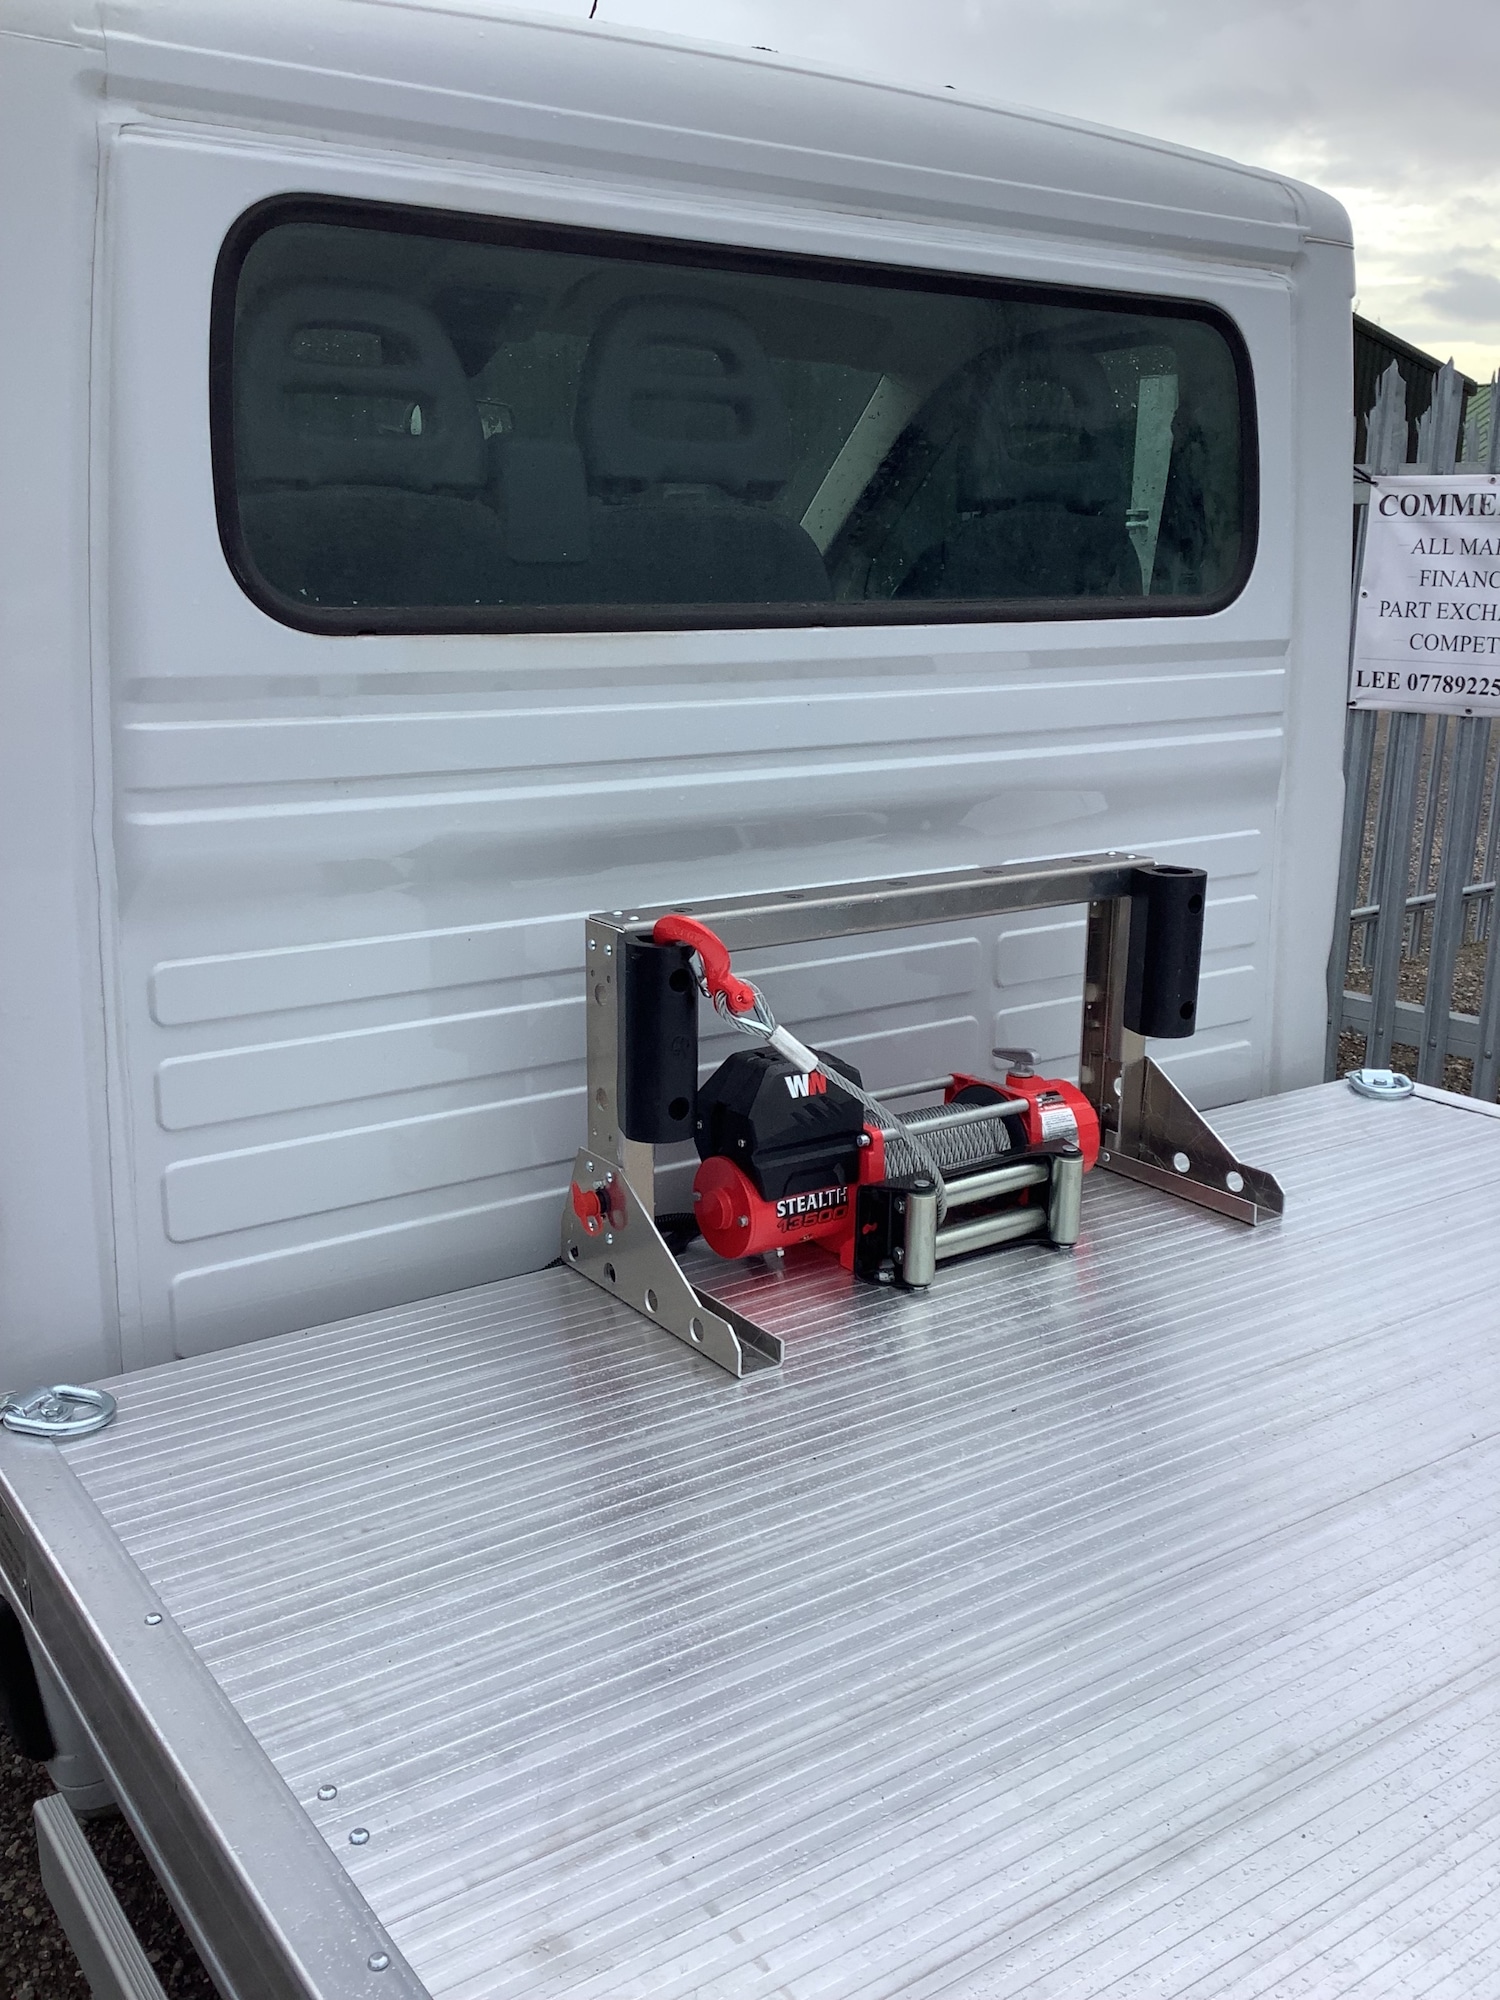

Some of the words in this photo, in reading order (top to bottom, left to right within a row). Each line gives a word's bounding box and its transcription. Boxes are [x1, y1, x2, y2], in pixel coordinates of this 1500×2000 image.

[1379, 493, 1500, 517] COMME
[1410, 537, 1455, 555] ALL
[1419, 569, 1500, 589] FINANC
[1379, 600, 1432, 619] PART
[1436, 602, 1500, 621] EXCH
[1409, 632, 1500, 654] COMPET
[1356, 669, 1401, 690] LEE
[1407, 672, 1500, 697] 07789225
[776, 1186, 848, 1218] STEALTH
[777, 1205, 848, 1233] 13500
